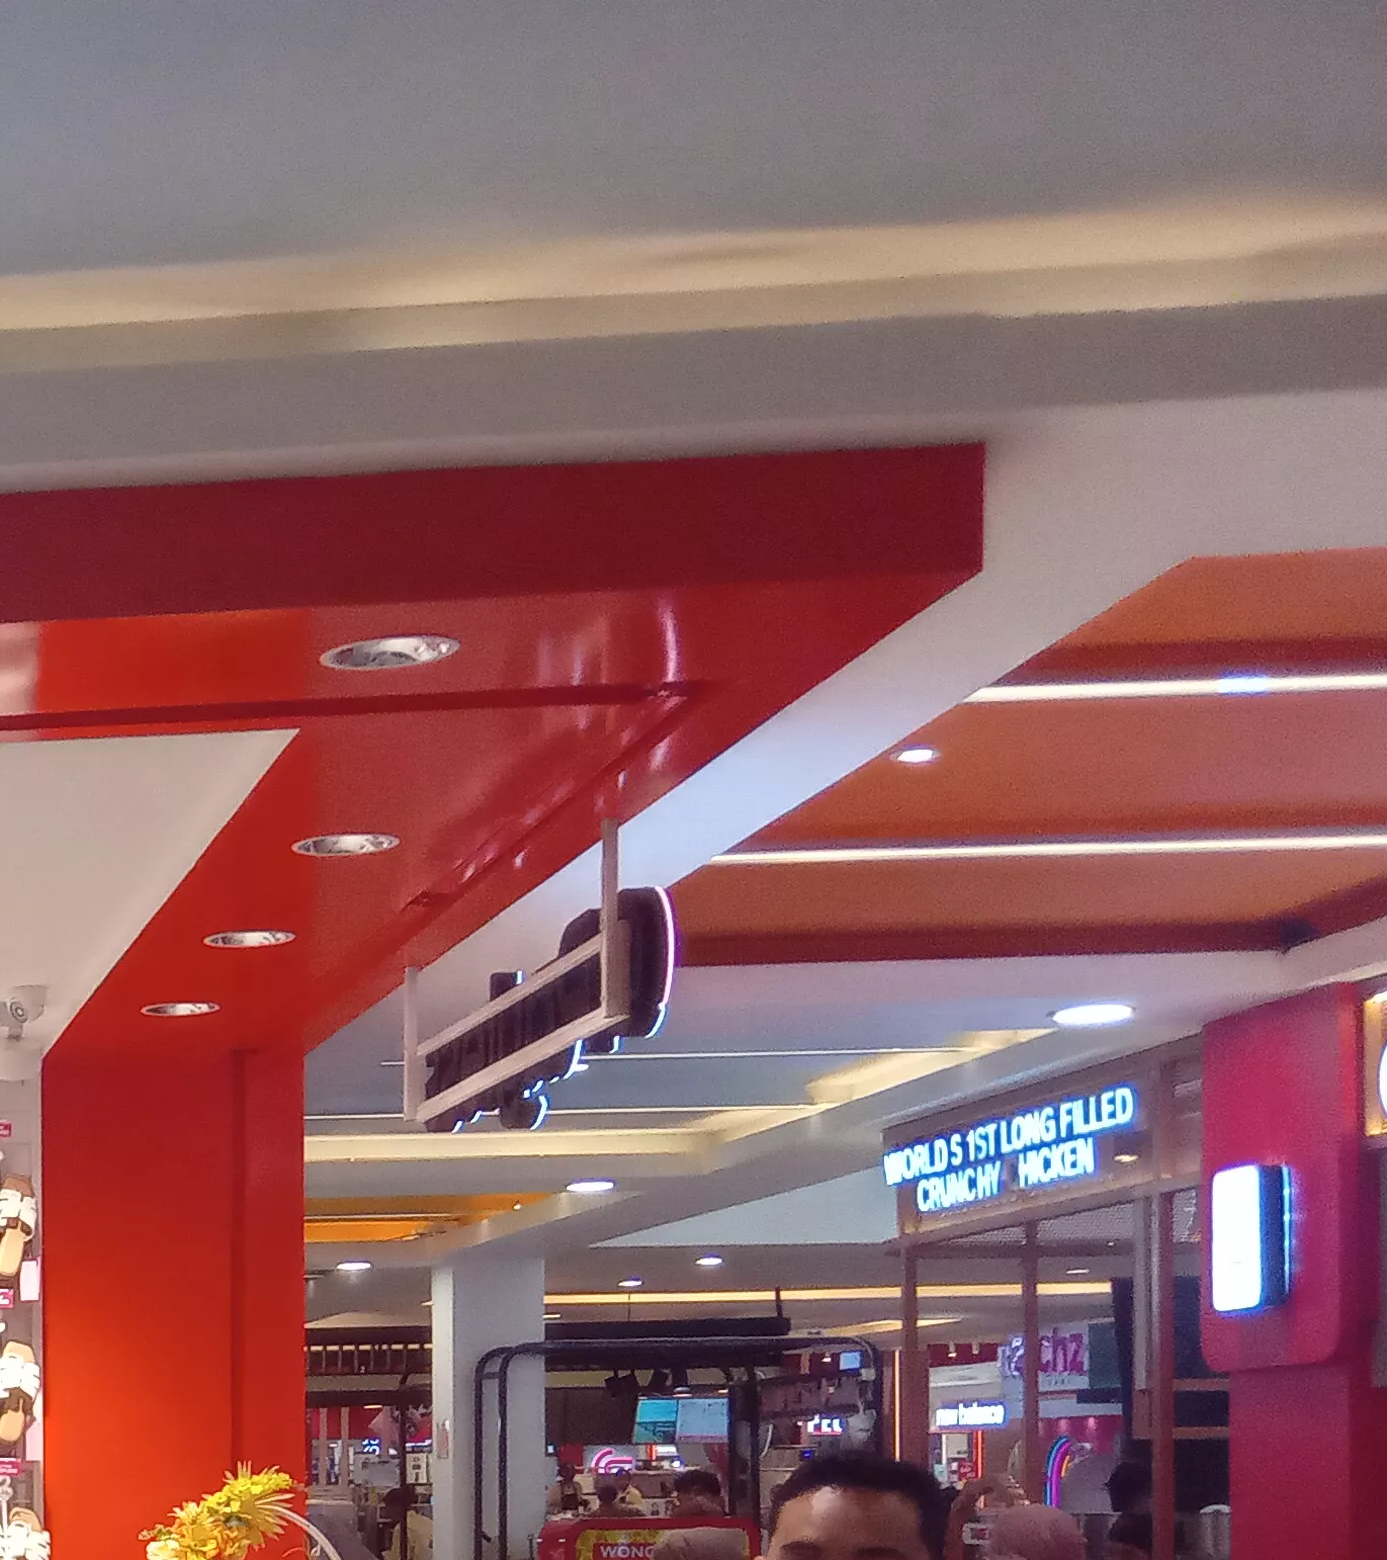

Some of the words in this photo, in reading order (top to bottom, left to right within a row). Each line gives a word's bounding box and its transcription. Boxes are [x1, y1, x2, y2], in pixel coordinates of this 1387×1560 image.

[967, 1122, 999, 1162] 1ST
[1000, 1106, 1056, 1155] LONG
[1059, 1087, 1134, 1139] FILLED
[916, 1161, 1002, 1213] CRUNCHY
[1007, 1137, 1095, 1189] HICKEN
